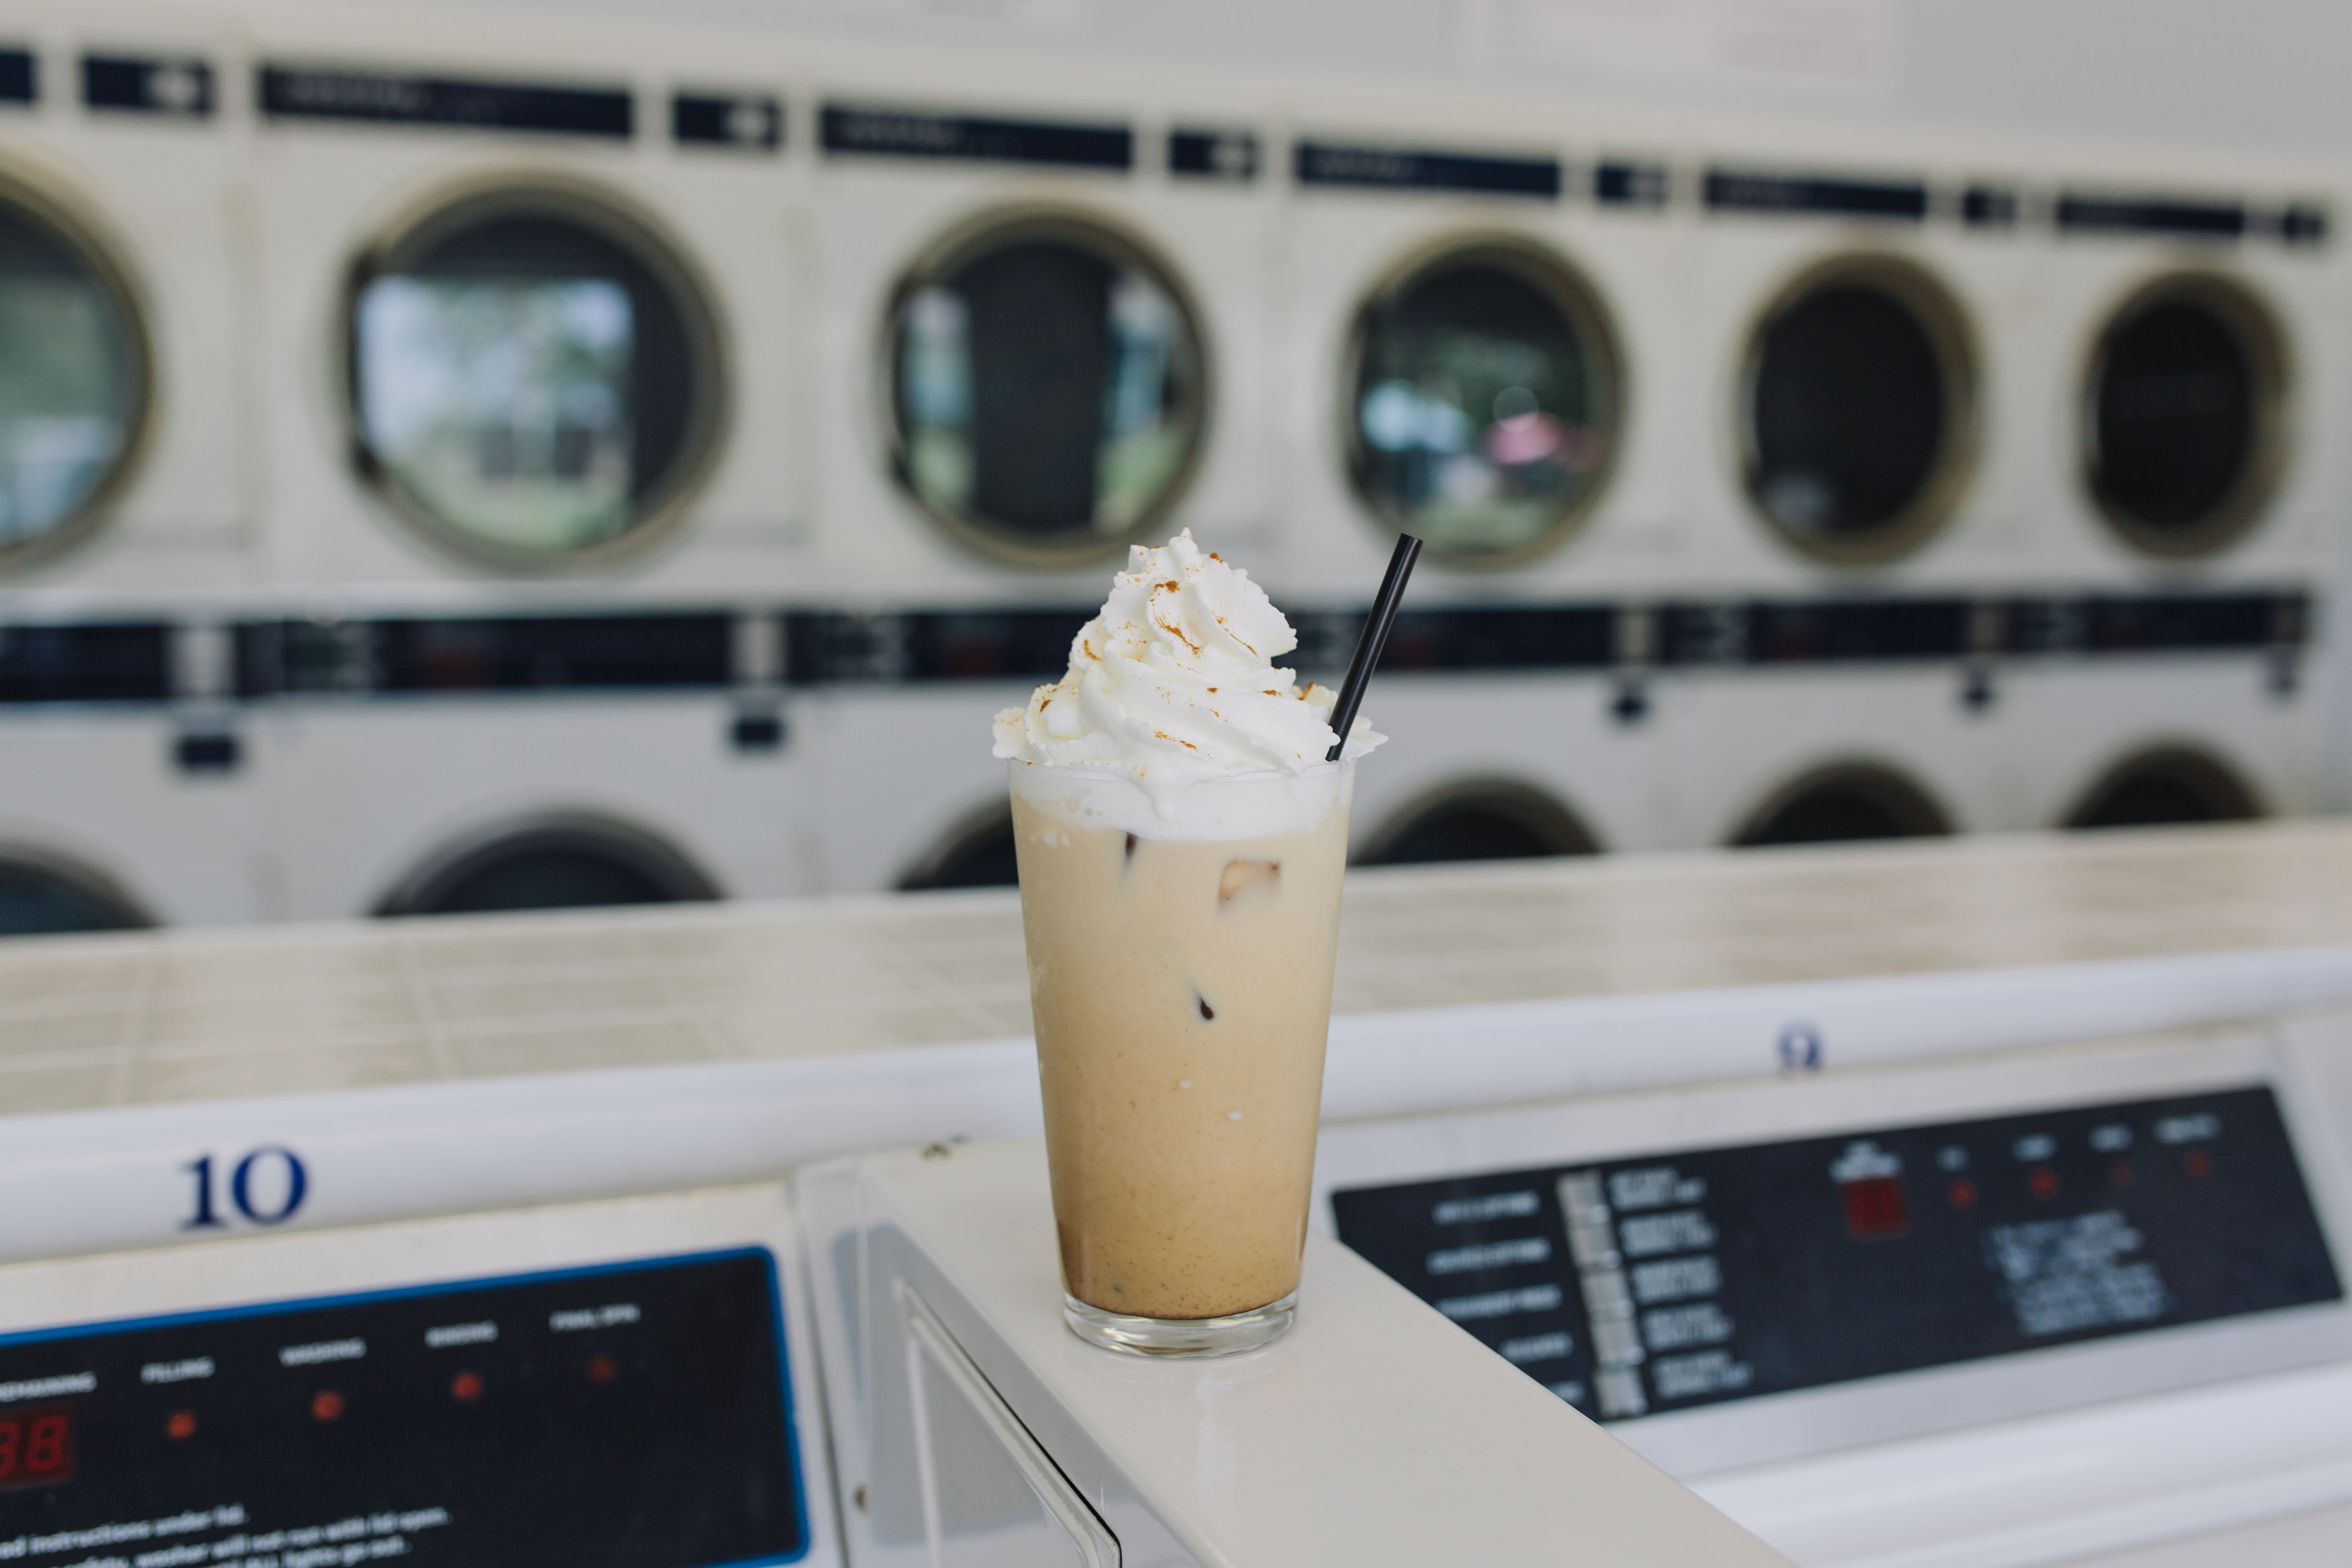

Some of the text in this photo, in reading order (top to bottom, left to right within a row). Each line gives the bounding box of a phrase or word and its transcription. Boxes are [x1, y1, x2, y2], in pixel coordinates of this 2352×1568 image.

[177, 1144, 308, 1230] 10
[142, 1357, 214, 1383] FILLING
[279, 1338, 366, 1367] WASHING
[0, 1372, 95, 1401] EMAINING
[30, 1522, 150, 1554] instructions
[155, 1511, 209, 1537] under
[136, 1544, 207, 1568] washer
[211, 1533, 248, 1559] will
[253, 1530, 283, 1551] not
[288, 1526, 320, 1546] run
[327, 1515, 365, 1541] with
[369, 1510, 396, 1533] lid
